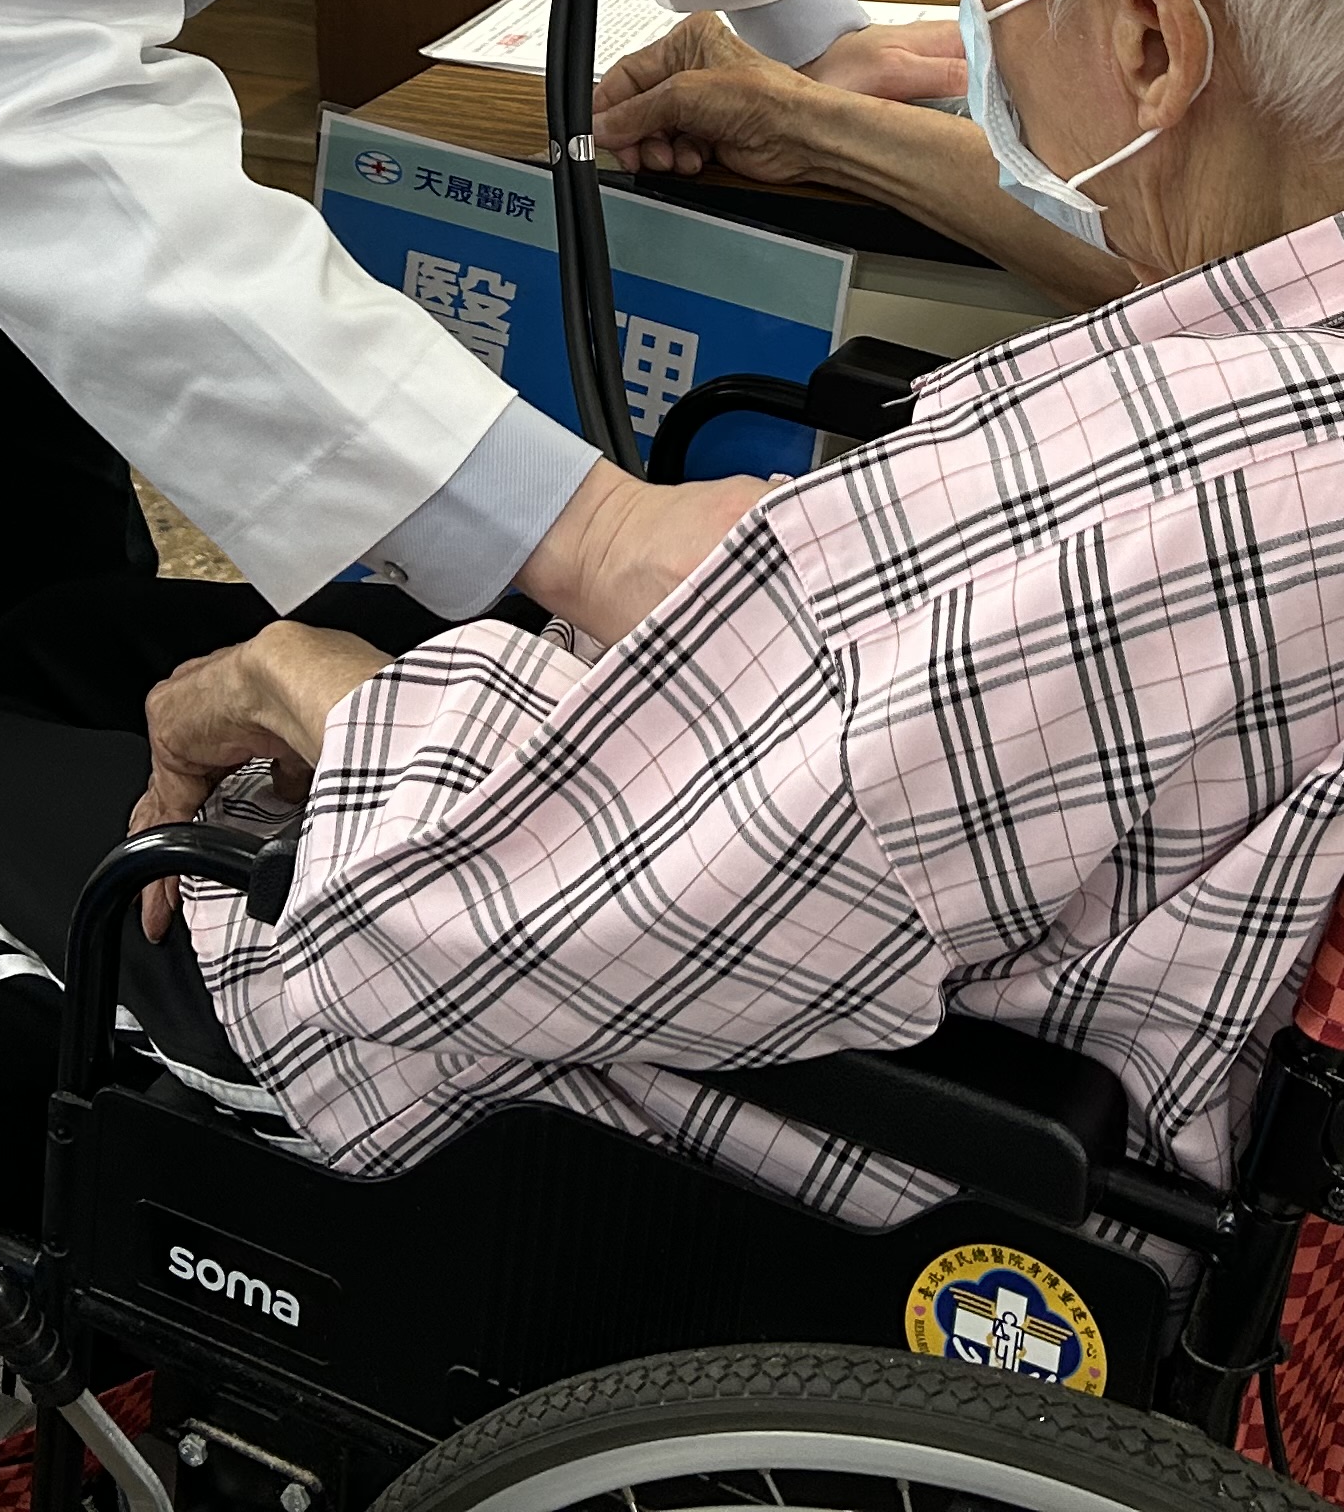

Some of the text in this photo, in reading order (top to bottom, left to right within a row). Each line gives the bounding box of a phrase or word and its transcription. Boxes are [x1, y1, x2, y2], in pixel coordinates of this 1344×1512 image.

[413, 166, 536, 223] 天晟醫院
[168, 1245, 300, 1327] soma
